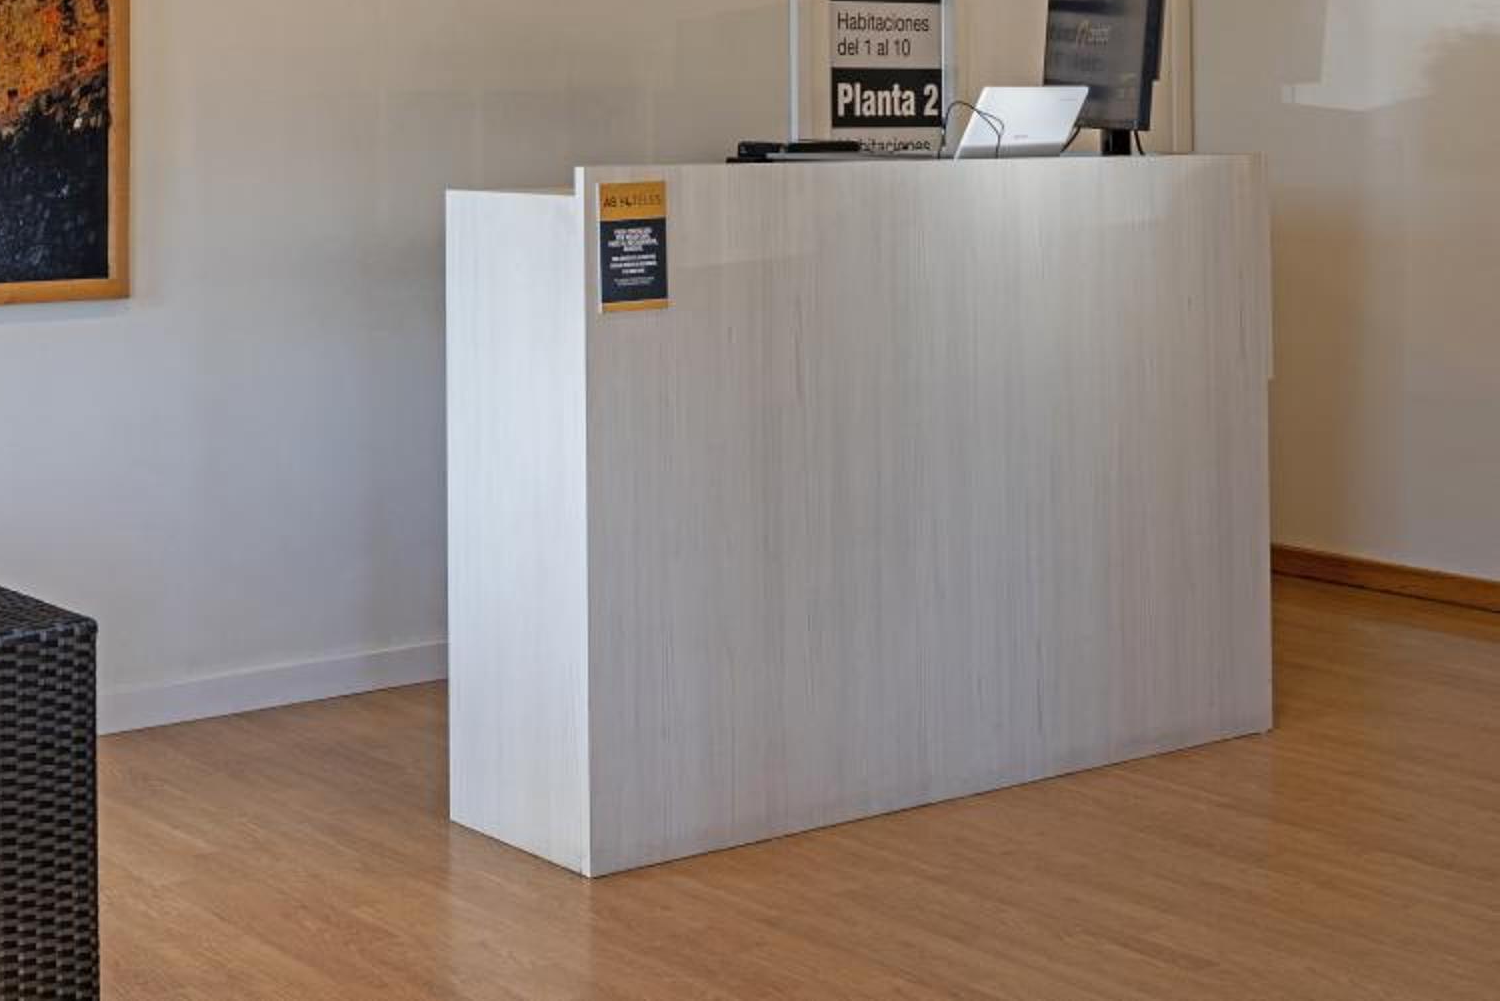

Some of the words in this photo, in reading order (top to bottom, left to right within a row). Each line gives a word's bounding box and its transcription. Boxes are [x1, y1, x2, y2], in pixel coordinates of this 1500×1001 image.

[836, 11, 930, 33] Habitaciones
[837, 37, 860, 56] del
[863, 38, 872, 56] 1
[876, 38, 890, 56] al
[893, 38, 912, 57] 10
[836, 81, 917, 117] Planta
[923, 83, 940, 116] 2
[838, 136, 932, 152] bitaciones
